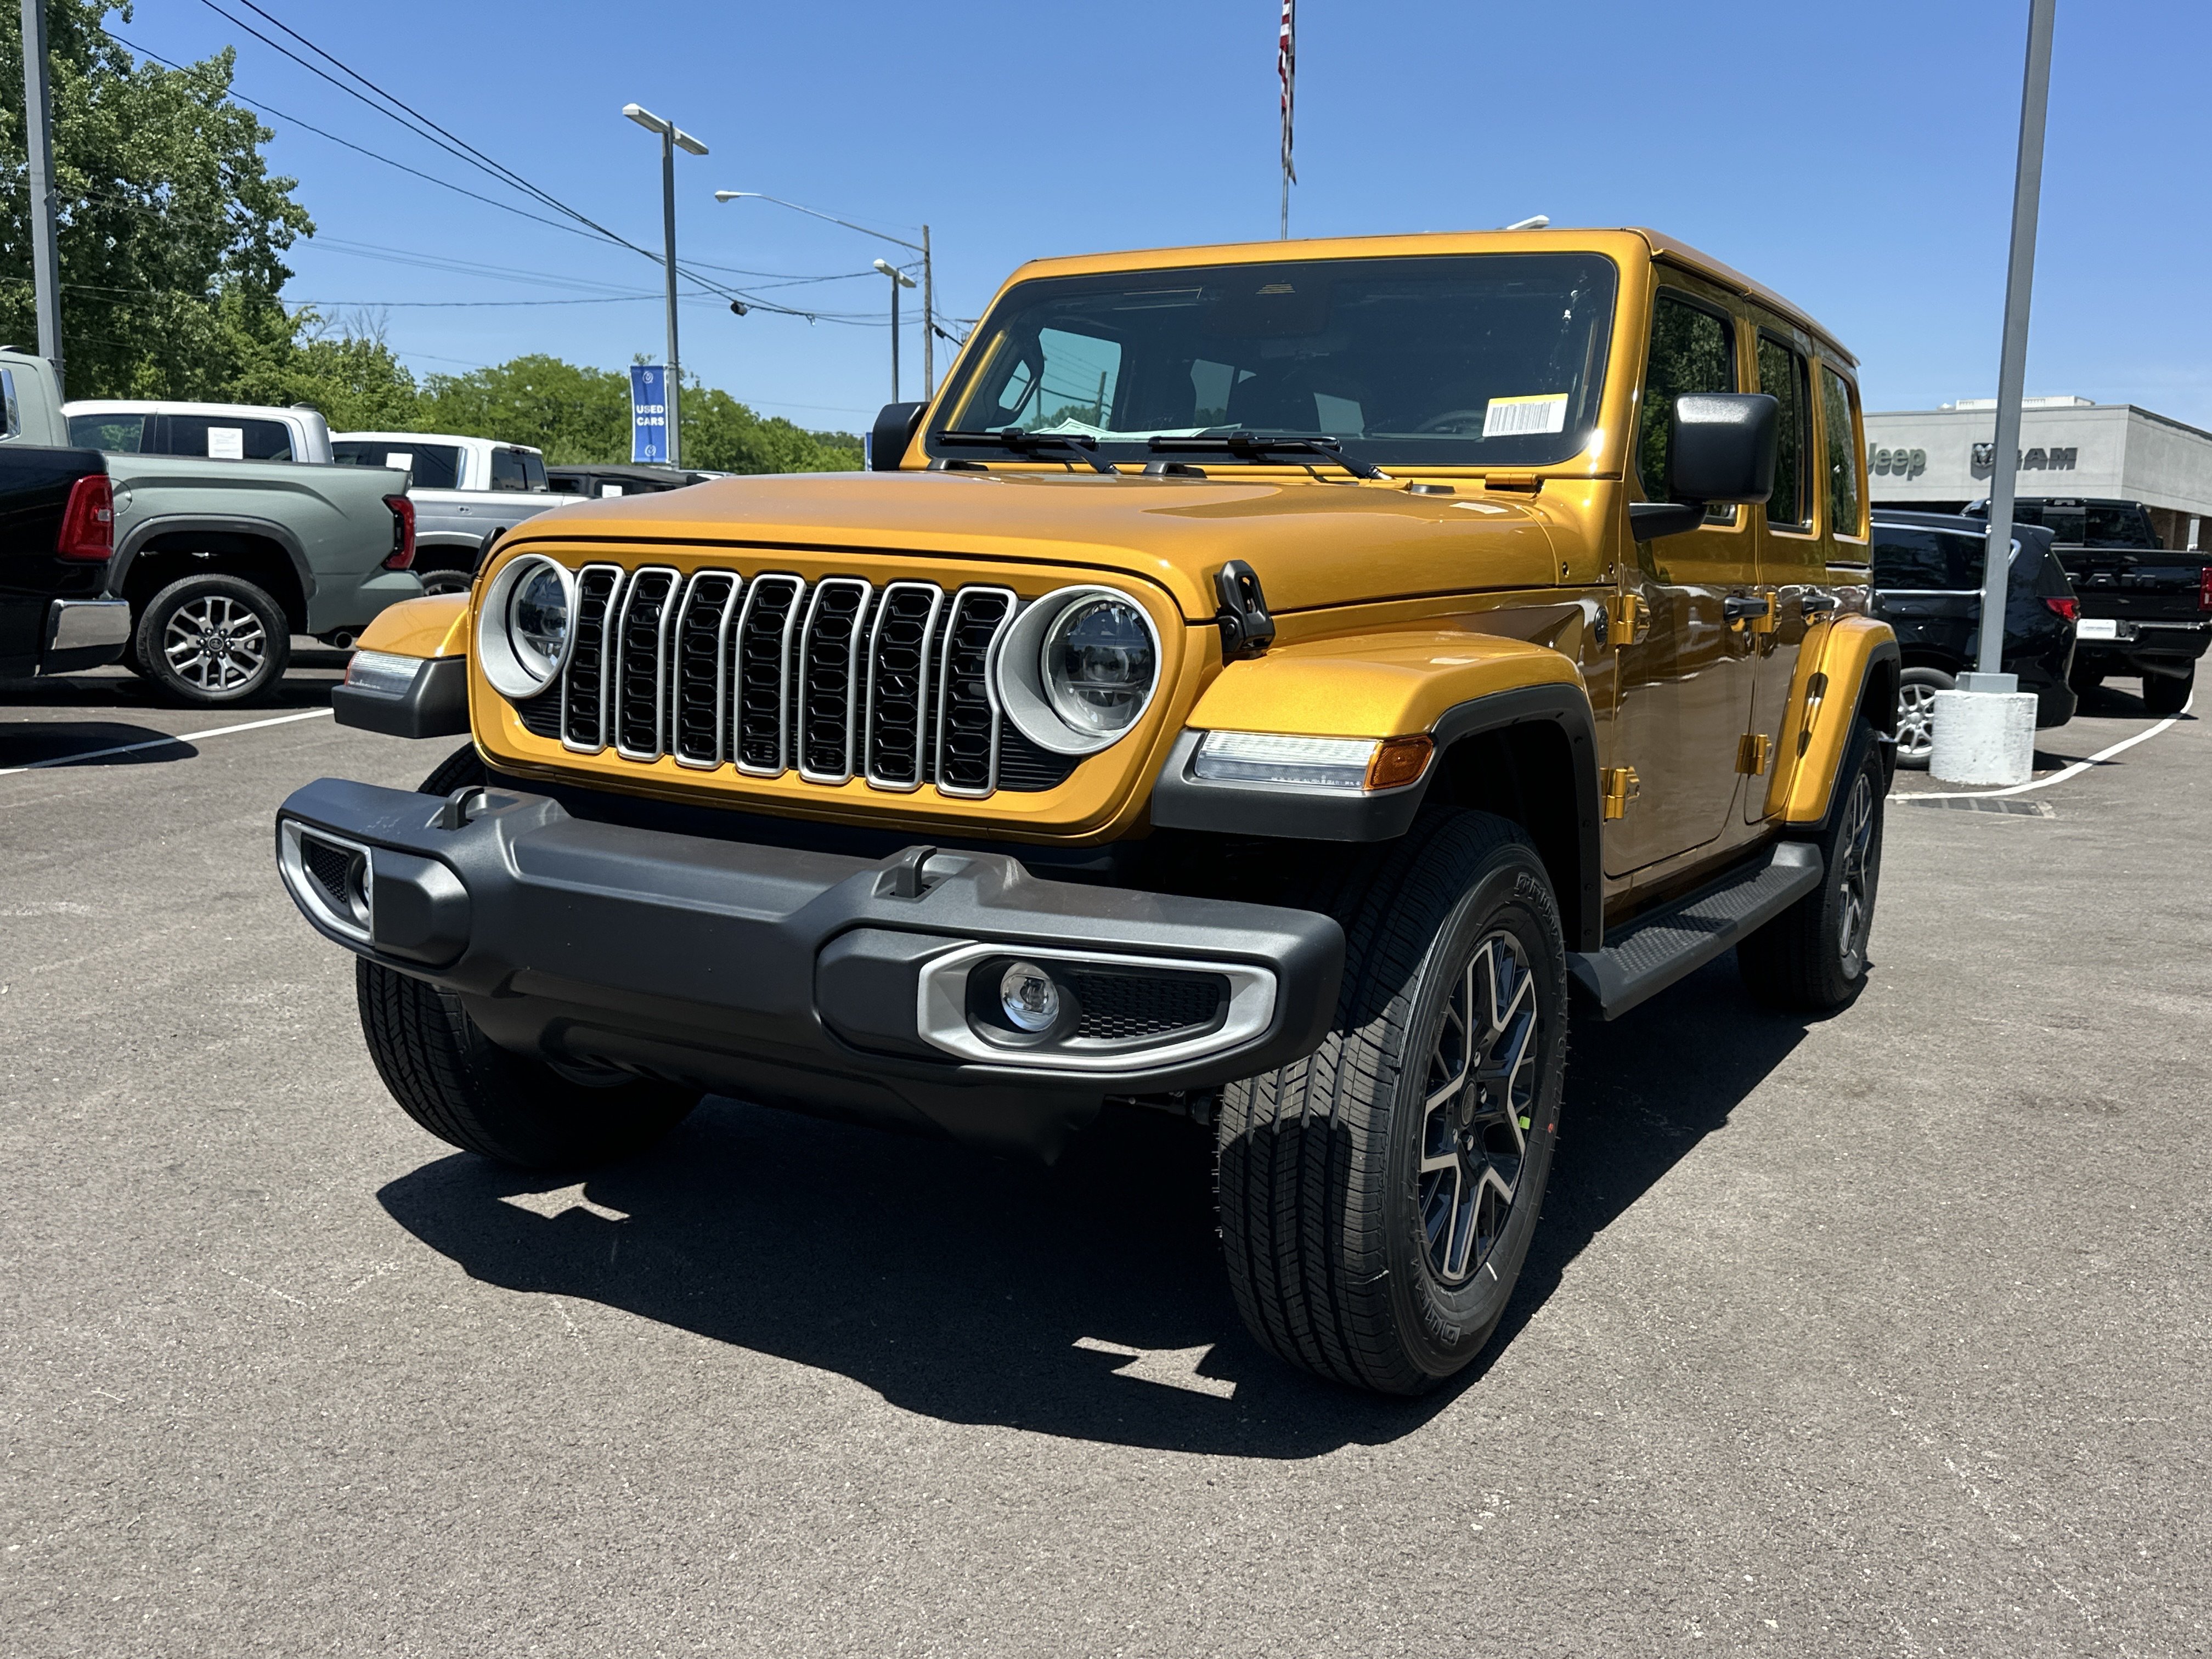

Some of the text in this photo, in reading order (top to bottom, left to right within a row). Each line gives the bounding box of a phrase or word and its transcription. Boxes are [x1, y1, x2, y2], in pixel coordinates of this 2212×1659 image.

[636, 405, 664, 414] USED
[636, 417, 664, 426] CARS
[1867, 442, 1926, 472] Jeep
[2016, 448, 2078, 464] AM
